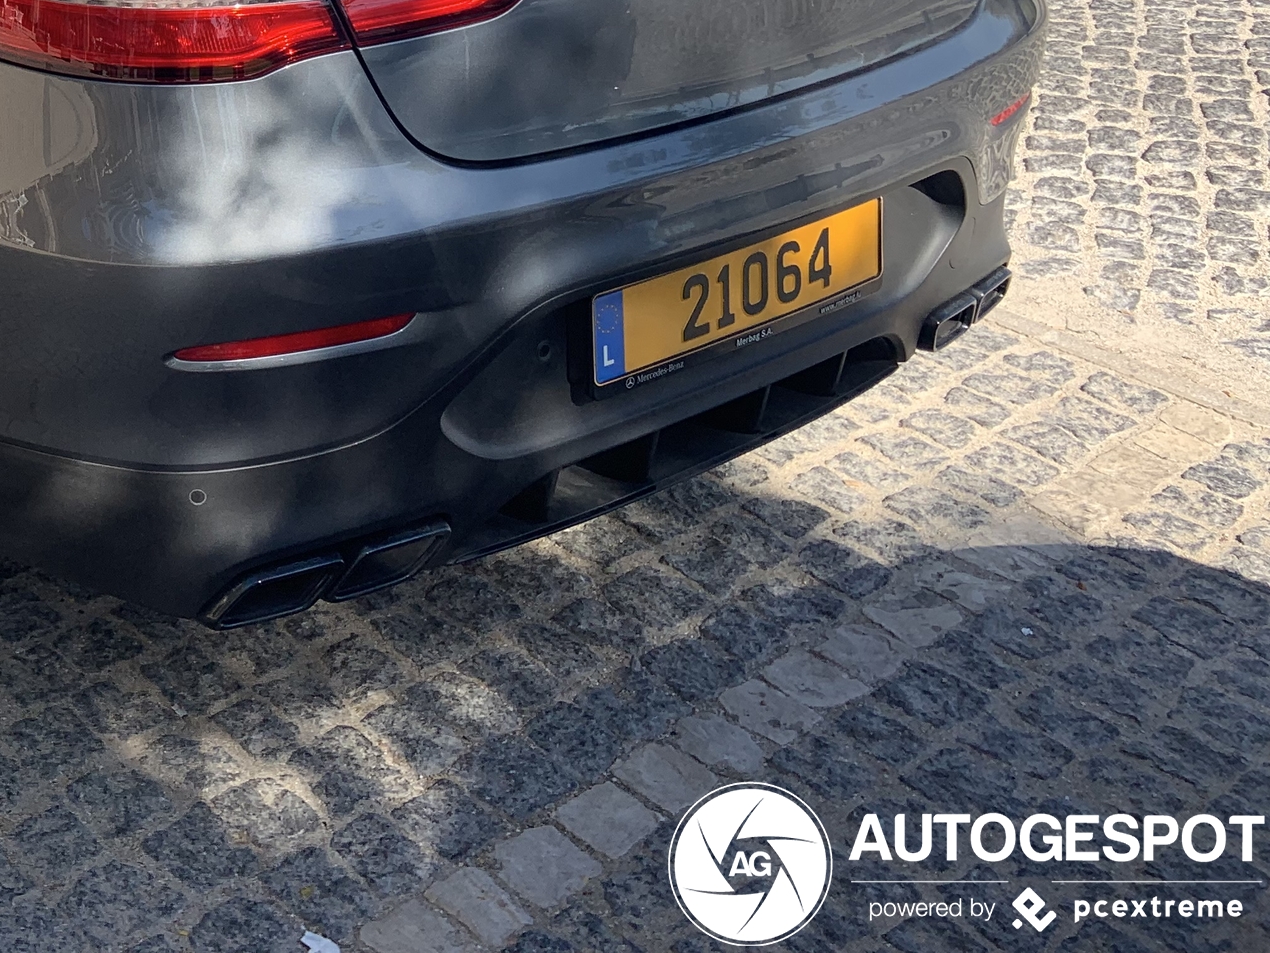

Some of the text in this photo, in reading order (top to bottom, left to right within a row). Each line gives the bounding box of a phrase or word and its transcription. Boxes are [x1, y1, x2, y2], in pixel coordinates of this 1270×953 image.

[682, 227, 832, 342] 21064
[736, 333, 761, 347] Merbag
[603, 345, 614, 367] L
[637, 360, 684, 385] Mercedes-Benz
